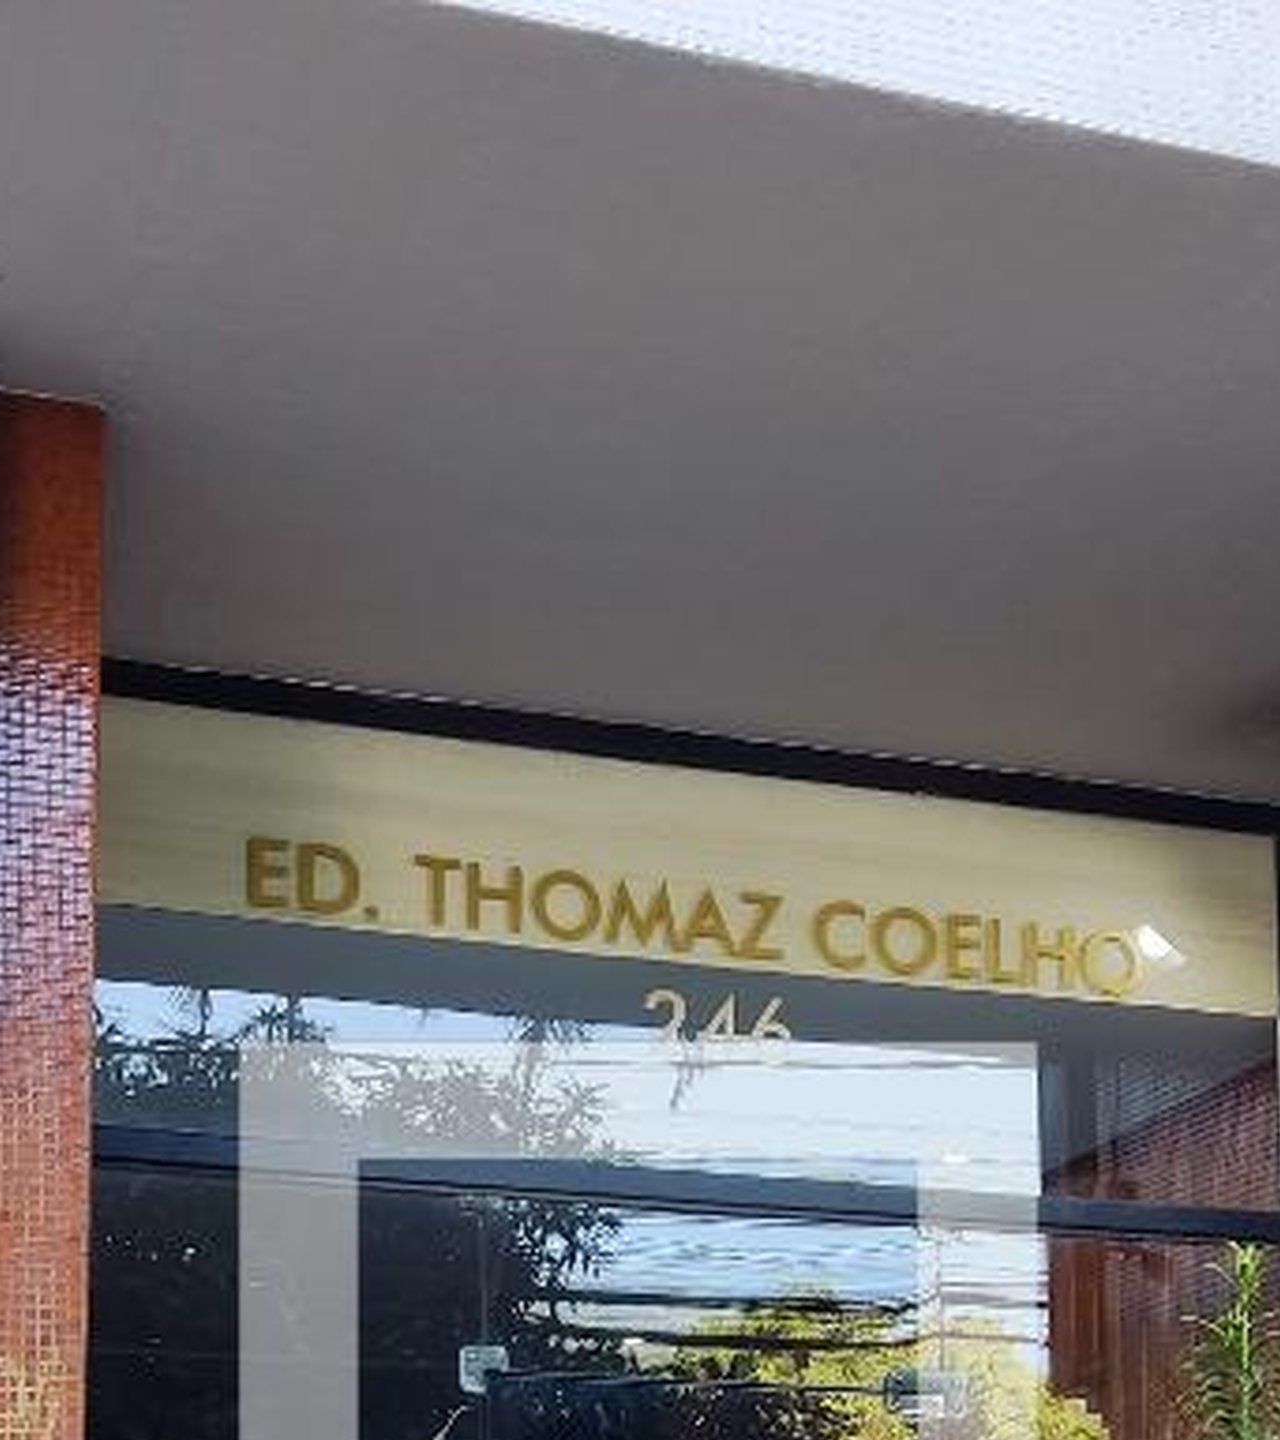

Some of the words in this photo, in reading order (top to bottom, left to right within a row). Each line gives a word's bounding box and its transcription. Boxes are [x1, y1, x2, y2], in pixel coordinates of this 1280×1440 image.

[246, 836, 379, 920] ED.
[414, 853, 784, 960] THOMAZ
[814, 899, 1138, 997] COELHO
